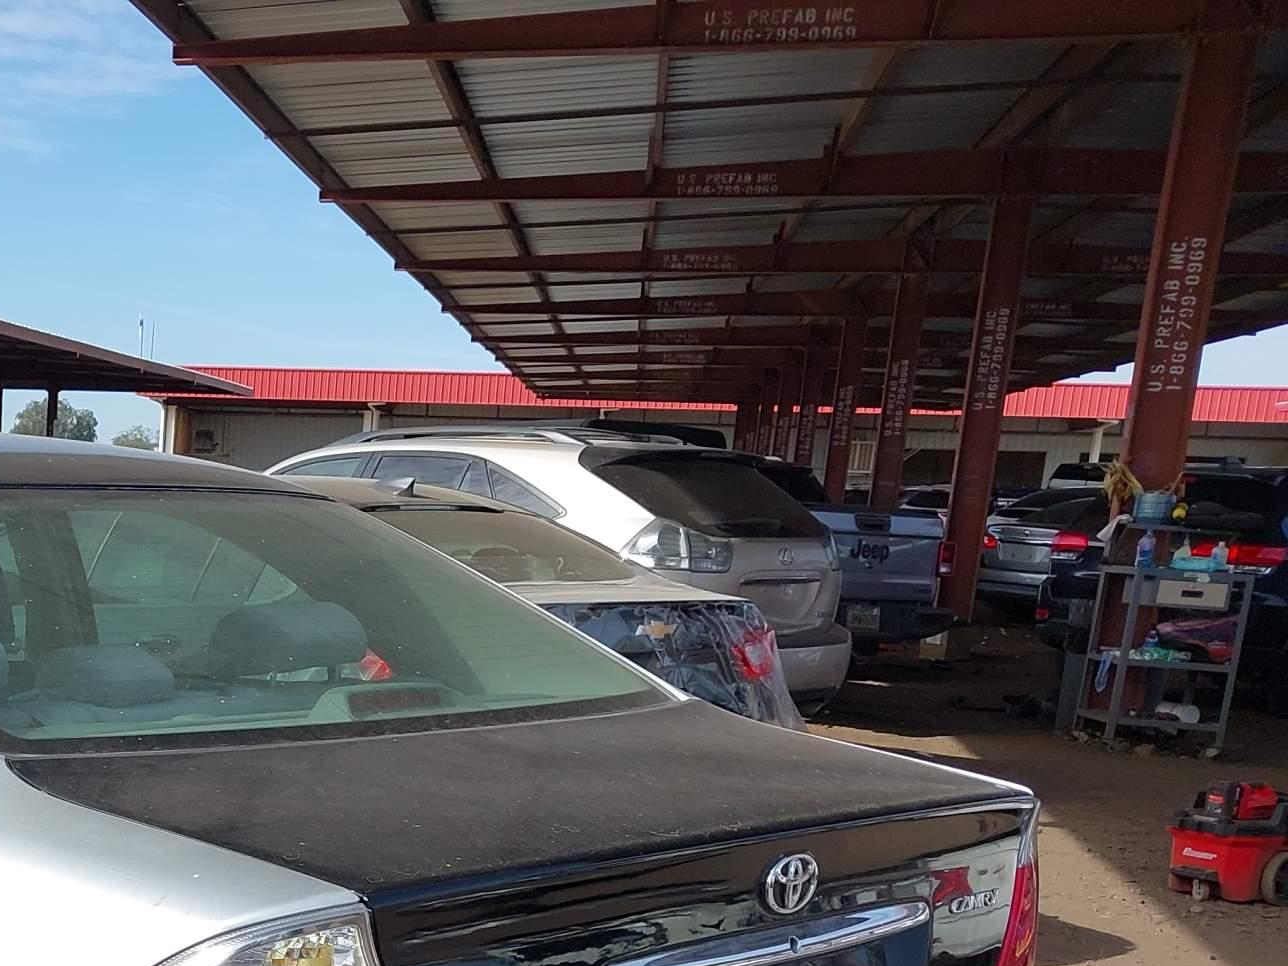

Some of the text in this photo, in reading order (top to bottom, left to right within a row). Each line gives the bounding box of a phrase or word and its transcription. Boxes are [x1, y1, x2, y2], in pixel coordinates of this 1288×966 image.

[747, 8, 817, 25] PREFAB
[704, 26, 857, 43] 1-866-799-0969
[705, 172, 753, 185] PREFAB
[1147, 236, 1189, 392] U.S. PREFAB INC.
[1166, 237, 1208, 390] 1-866-799-0969
[977, 335, 993, 381] PREFAB
[985, 307, 1010, 409] 1-866-799-0969
[850, 538, 890, 564] Jeep
[950, 888, 1000, 914] CAMRY
